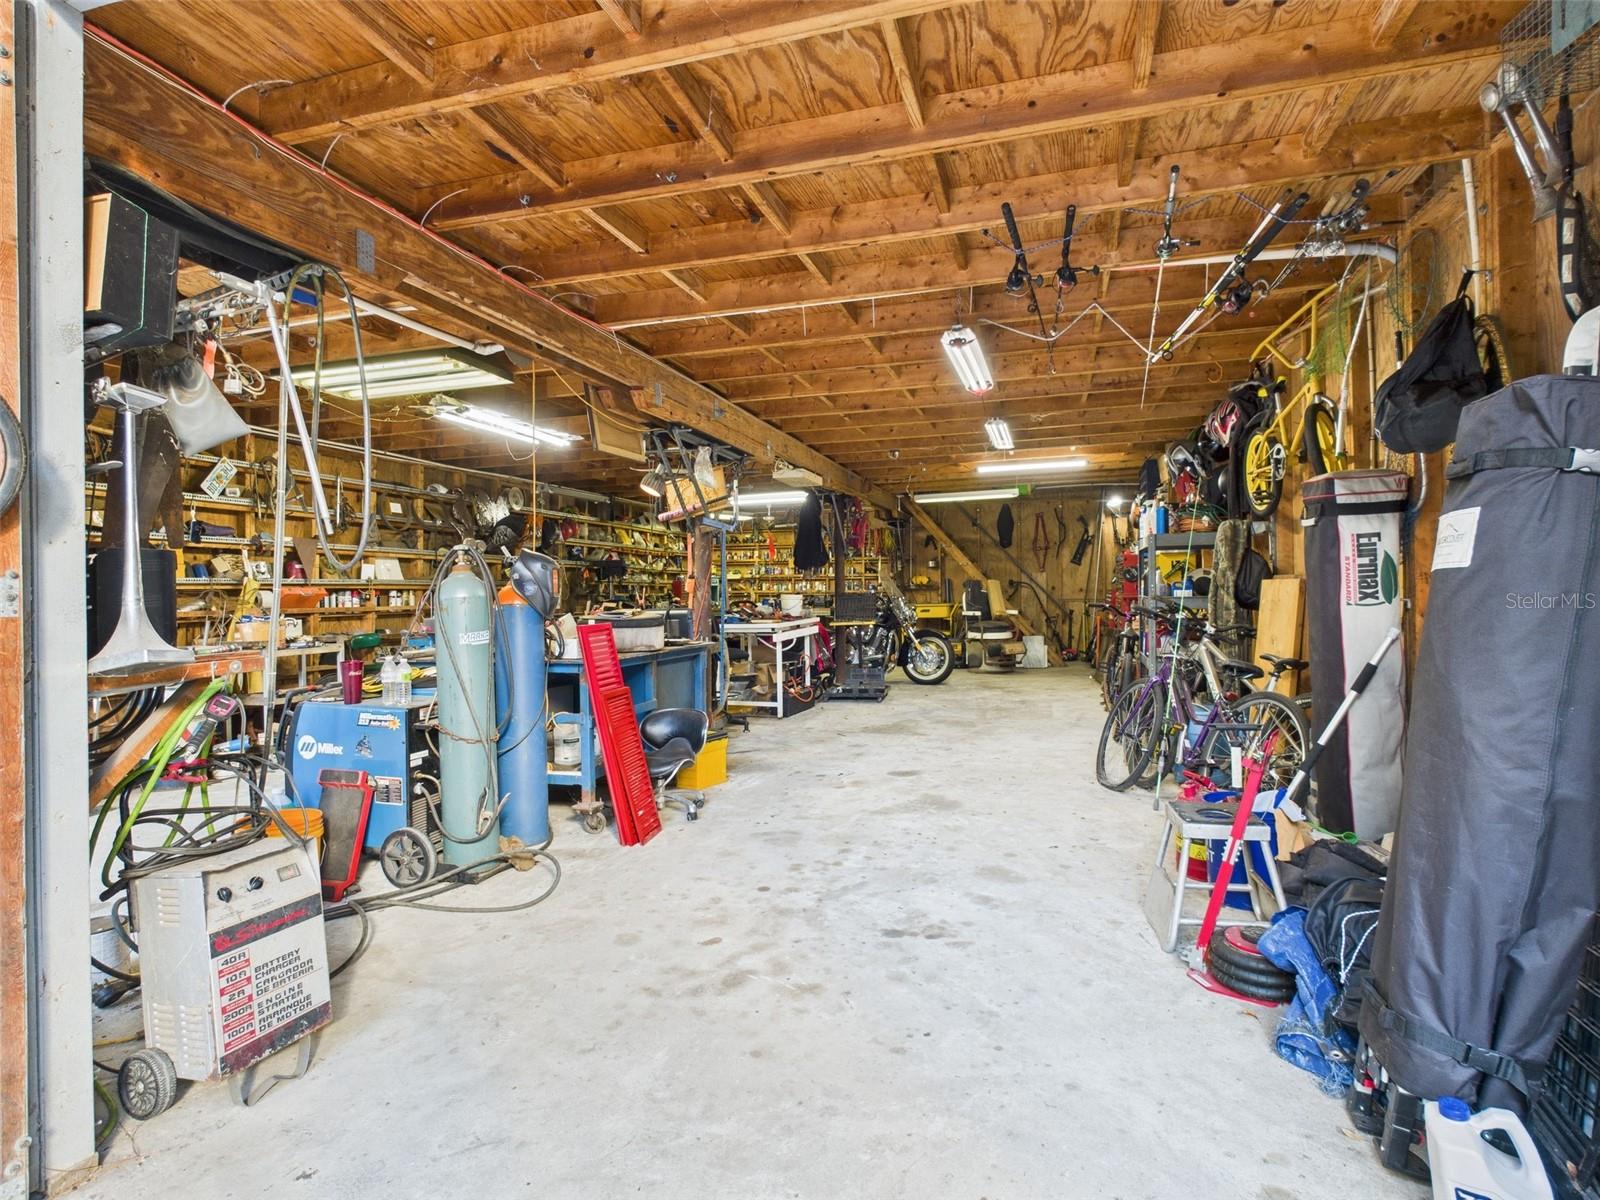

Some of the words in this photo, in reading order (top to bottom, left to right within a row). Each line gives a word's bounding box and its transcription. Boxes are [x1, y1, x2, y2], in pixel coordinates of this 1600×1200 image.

[1344, 555, 1352, 602] STANDARD
[1356, 532, 1381, 602] Eurmax
[317, 742, 344, 755] Miller
[221, 952, 246, 967] 40A
[254, 948, 300, 973] BATTERY
[255, 955, 301, 980] CHARGER
[225, 970, 247, 984] 10A
[255, 958, 313, 989] CARGADOR
[256, 988, 270, 997] DE
[272, 965, 314, 988] BATERIA
[227, 989, 246, 1002] 2A
[257, 982, 303, 1008] ENGINE
[257, 989, 303, 1016] STARTER
[224, 1004, 253, 1022] 200A
[258, 994, 312, 1024] ARRANQUE
[259, 1022, 273, 1032] DE
[276, 1000, 313, 1023] MOTOR
[227, 1022, 254, 1039] 100A
